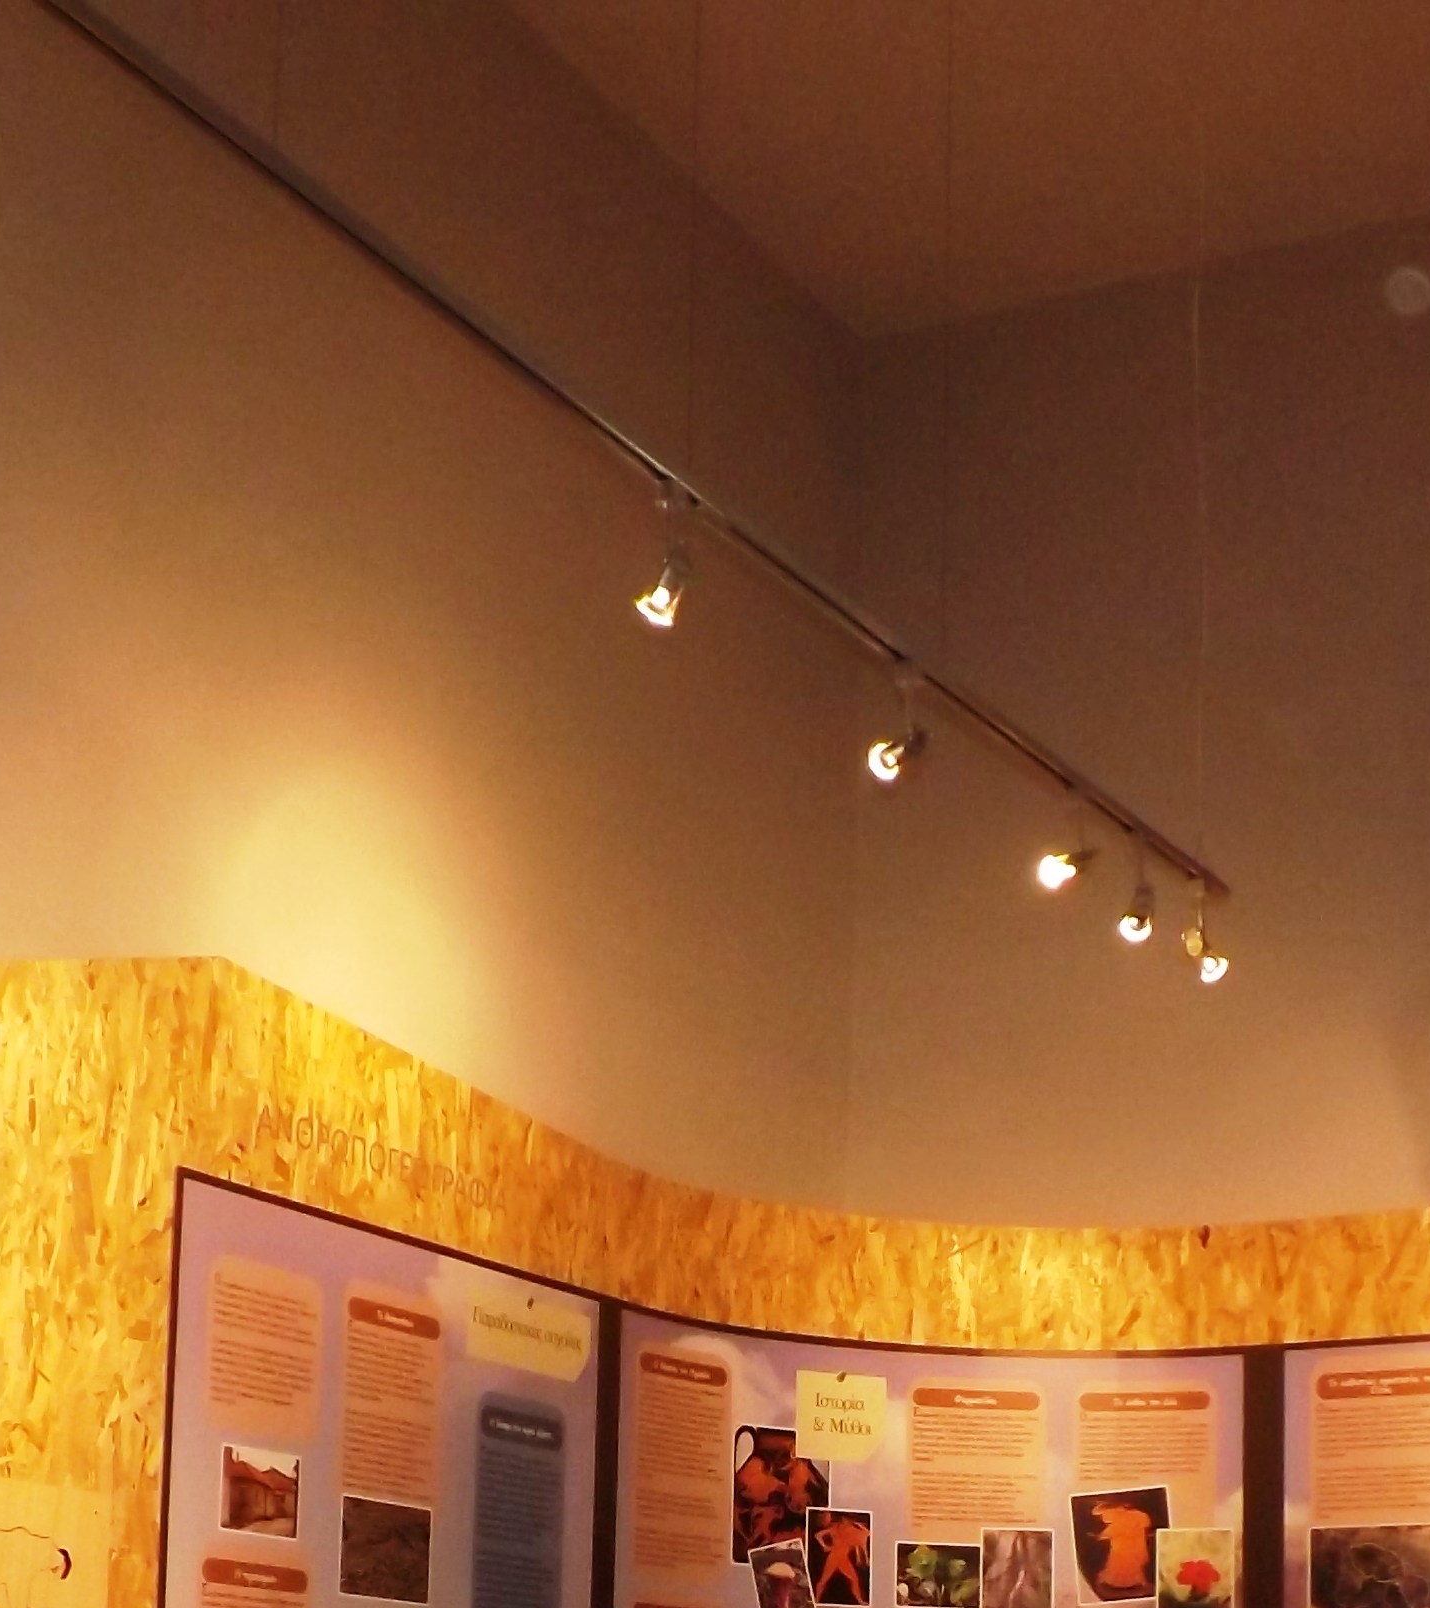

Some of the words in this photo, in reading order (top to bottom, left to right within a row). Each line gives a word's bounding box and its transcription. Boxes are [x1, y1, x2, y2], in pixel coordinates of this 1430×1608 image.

[816, 1392, 865, 1412] Ιστορία
[813, 1416, 824, 1432] &
[829, 1416, 871, 1436] Μύθοι
